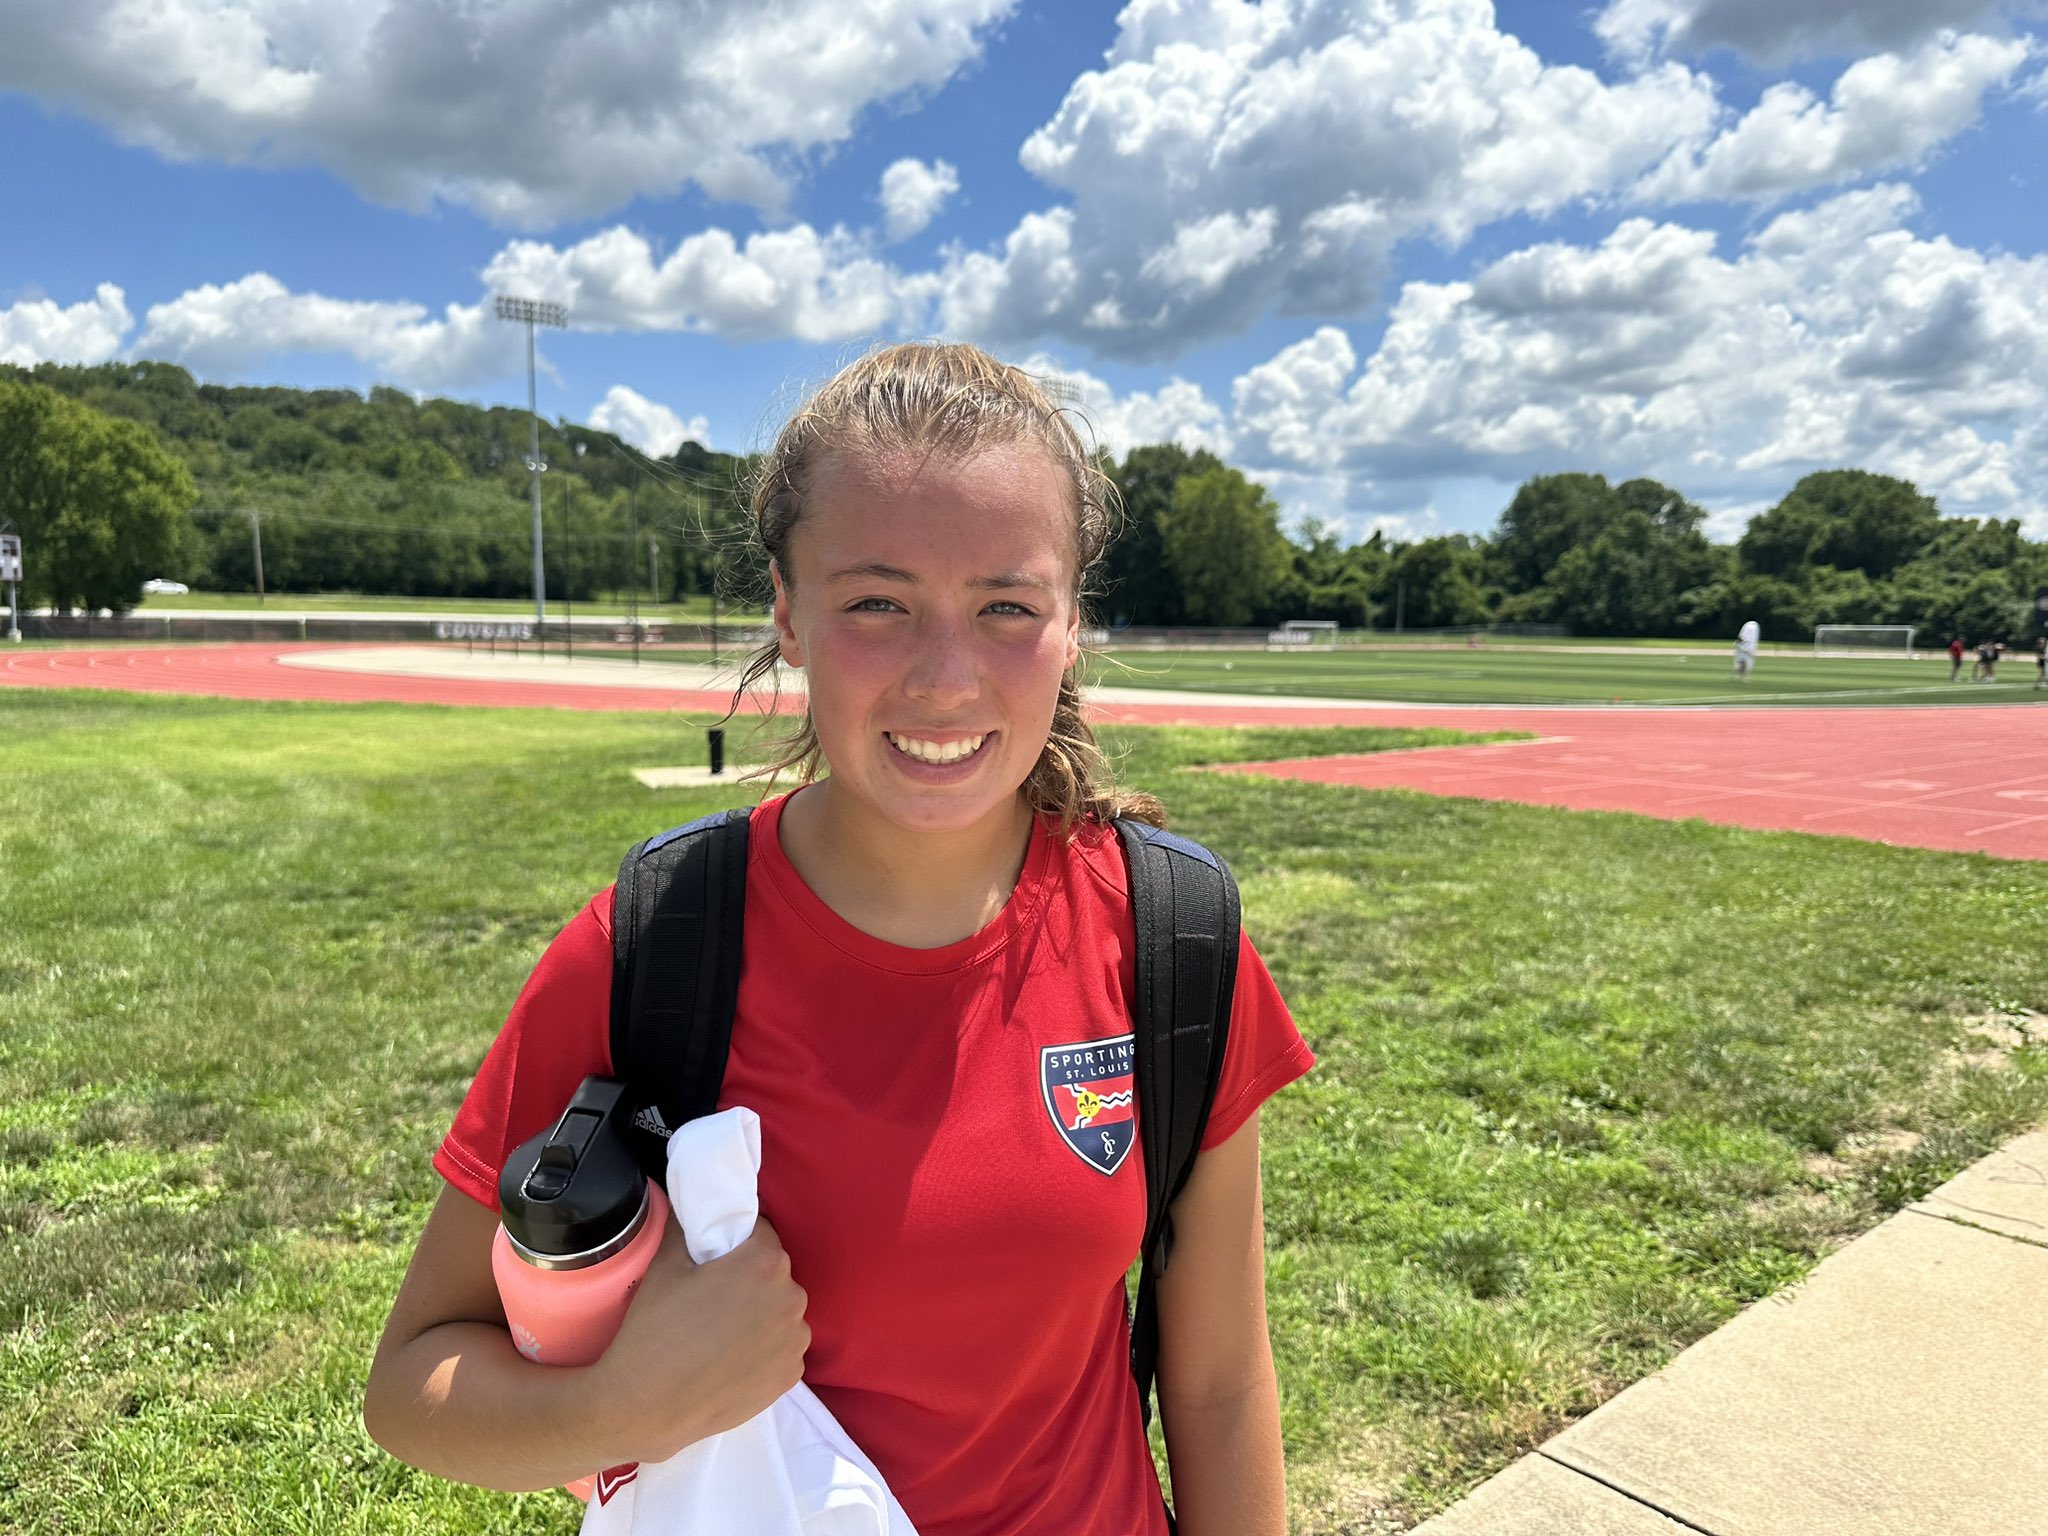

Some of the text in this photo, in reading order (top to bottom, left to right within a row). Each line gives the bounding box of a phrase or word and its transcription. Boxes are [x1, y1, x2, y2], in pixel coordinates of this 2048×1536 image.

[1050, 1043, 1135, 1069] SPORTING
[1065, 1061, 1129, 1080] ST. LOUIS
